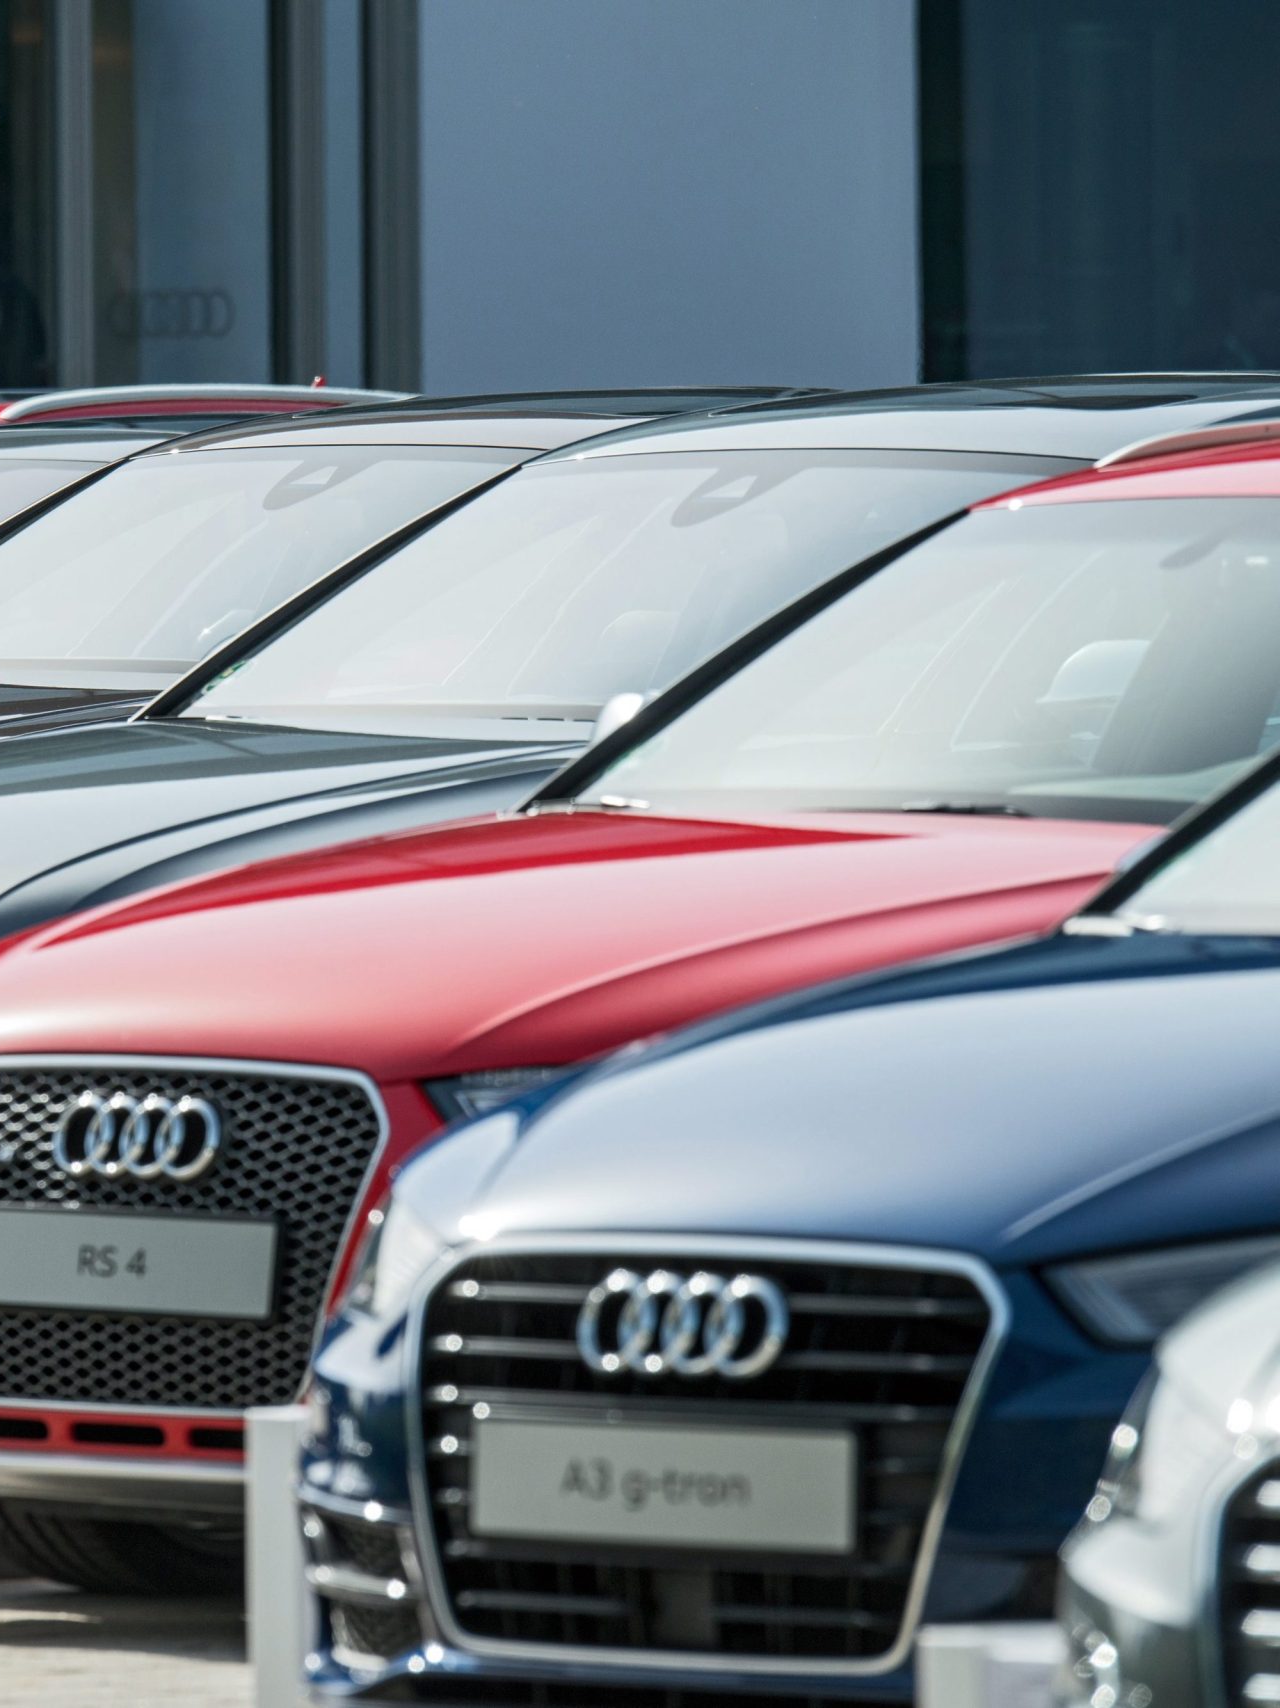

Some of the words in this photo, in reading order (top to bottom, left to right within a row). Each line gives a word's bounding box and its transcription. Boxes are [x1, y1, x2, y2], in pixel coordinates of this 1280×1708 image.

[77, 1243, 119, 1278] RS
[125, 1247, 146, 1278] 4
[560, 1457, 615, 1501] A3
[621, 1468, 753, 1513] g-tron
